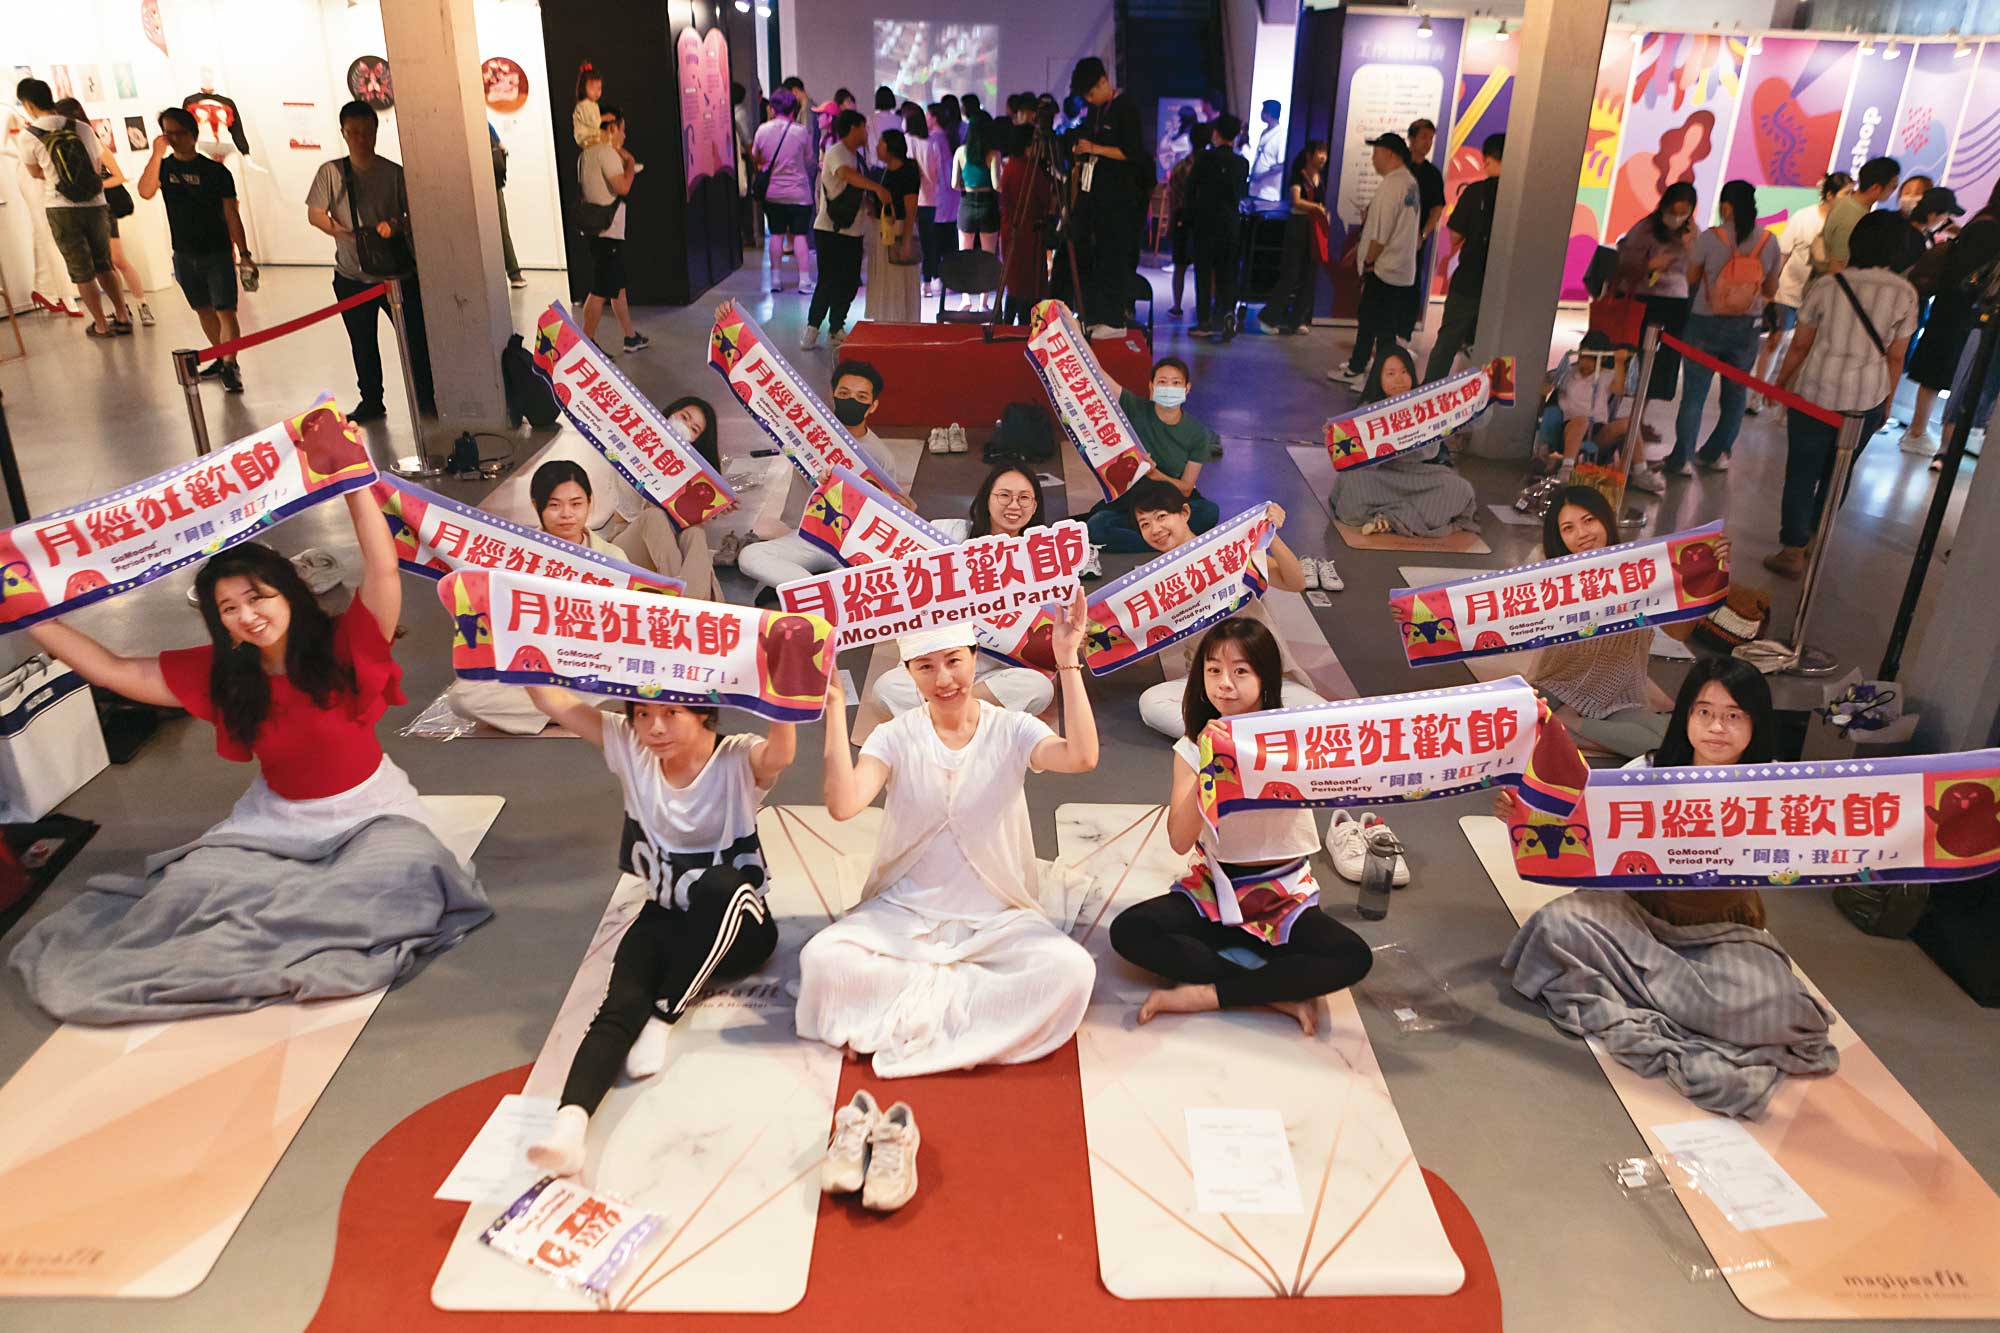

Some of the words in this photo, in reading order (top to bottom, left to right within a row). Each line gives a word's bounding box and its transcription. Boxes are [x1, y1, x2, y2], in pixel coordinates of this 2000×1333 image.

[564, 357, 686, 477] 月經狂歡節
[1047, 331, 1121, 448] 月經狂歡節
[1366, 378, 1482, 441] 月經狂歡節
[34, 441, 281, 567] 月經狂歡節
[115, 557, 147, 573] Period
[149, 546, 172, 562] Party
[782, 527, 1084, 628] 月經狂歡節
[1464, 557, 1657, 625] 月經狂歡節
[507, 589, 741, 658] 月經狂歡節
[932, 599, 1006, 626] Period
[1014, 583, 1075, 609] Party
[1511, 627, 1534, 637] Period
[1536, 624, 1555, 635] Party
[557, 658, 586, 669] Period
[589, 661, 613, 673] Party
[1253, 706, 1518, 773] 月經狂歡節
[1341, 784, 1372, 793] Party
[1607, 791, 1902, 839] 月經狂歡節
[1668, 857, 1703, 865] Period
[1706, 857, 1734, 866] Party
